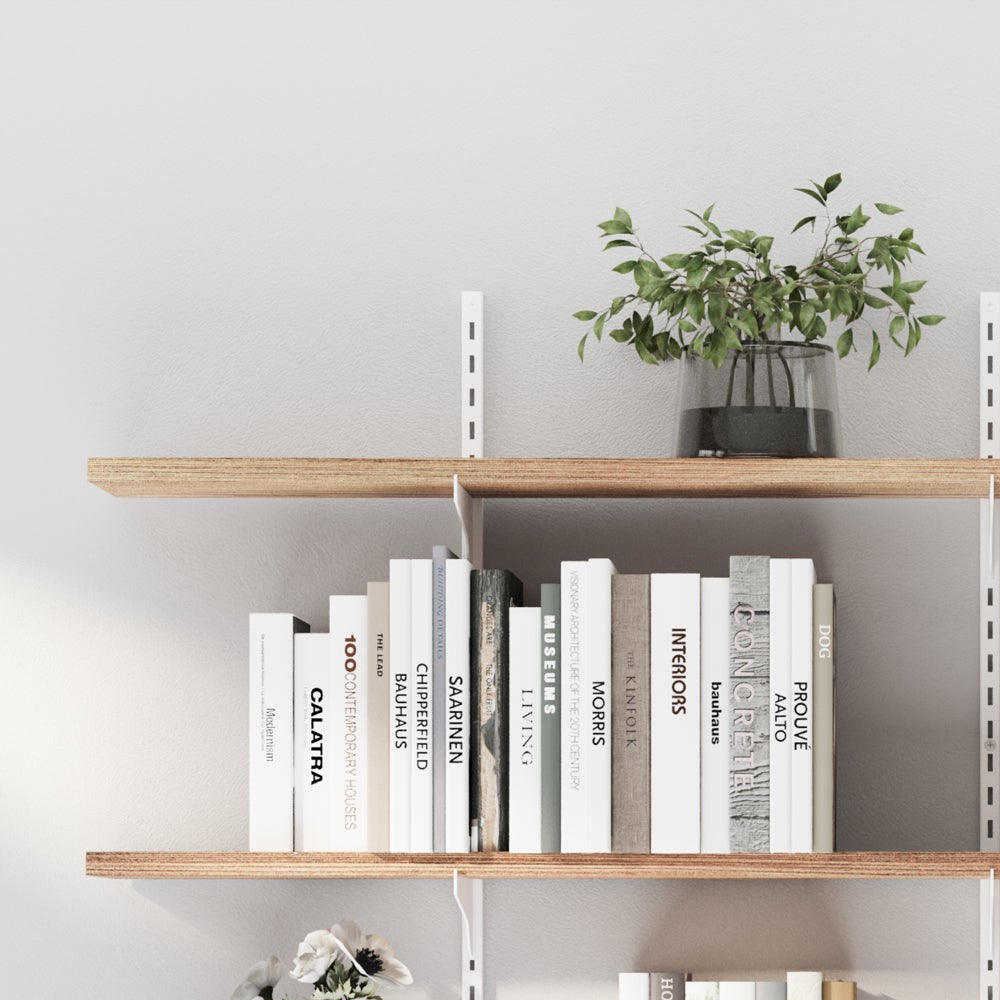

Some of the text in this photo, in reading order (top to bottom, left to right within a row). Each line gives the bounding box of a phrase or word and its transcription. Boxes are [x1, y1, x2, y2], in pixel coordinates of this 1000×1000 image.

[543, 615, 556, 714] MUSEUMS
[569, 615, 580, 680] ARCHITECTURE
[671, 628, 686, 715] INTERIORS
[818, 624, 830, 659] DOG
[395, 673, 407, 749] BAUHAUS
[416, 663, 428, 770] CHIPPERFIELD
[449, 676, 462, 764] SAARINEN
[521, 689, 533, 766] LIVING
[569, 698, 580, 715] THE
[592, 682, 605, 746] MORRIS
[625, 675, 637, 748] KINFOLK
[711, 682, 722, 745] bauhaus
[732, 603, 755, 789] CONCRETE
[774, 693, 786, 742] AALTO
[794, 681, 811, 750] PROUVÉ
[266, 708, 274, 762] Modernism
[310, 688, 323, 785] CALATRA
[344, 781, 356, 831] HOUSES
